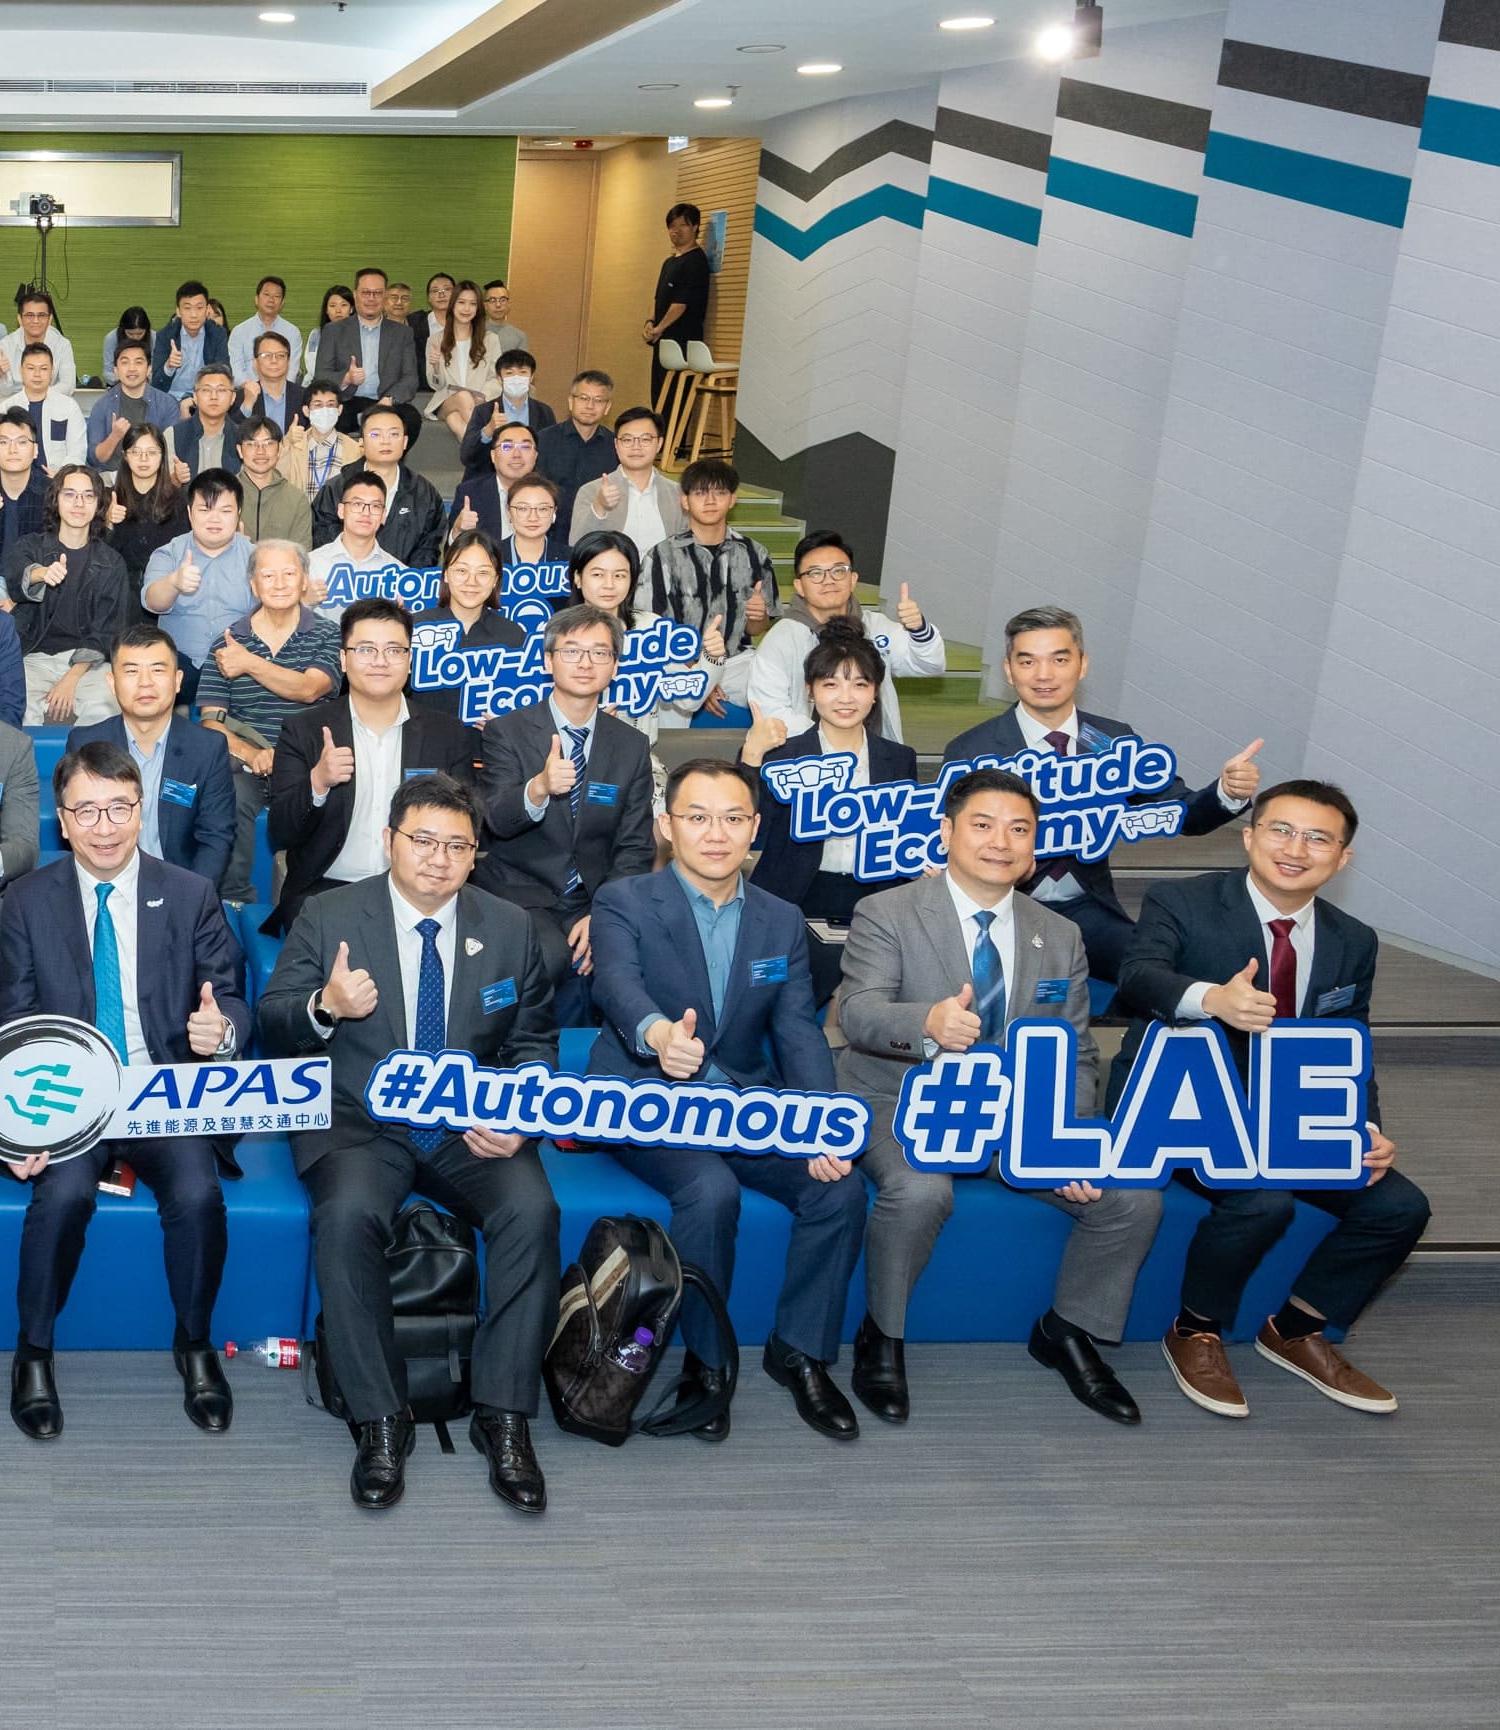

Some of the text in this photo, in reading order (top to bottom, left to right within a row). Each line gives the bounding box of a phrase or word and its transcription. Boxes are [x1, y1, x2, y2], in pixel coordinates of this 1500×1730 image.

[329, 564, 572, 602] Autonou
[417, 622, 700, 688] Low-Aude
[464, 669, 660, 724] Ecomy
[800, 743, 1170, 835] Low-itude
[860, 806, 1123, 878] Ecomy
[128, 1060, 329, 1111] APAS
[384, 1061, 856, 1146] #Autonomous
[912, 1033, 1356, 1168] #LAE
[127, 1111, 331, 1137] 先進能源及智慧交通中心
